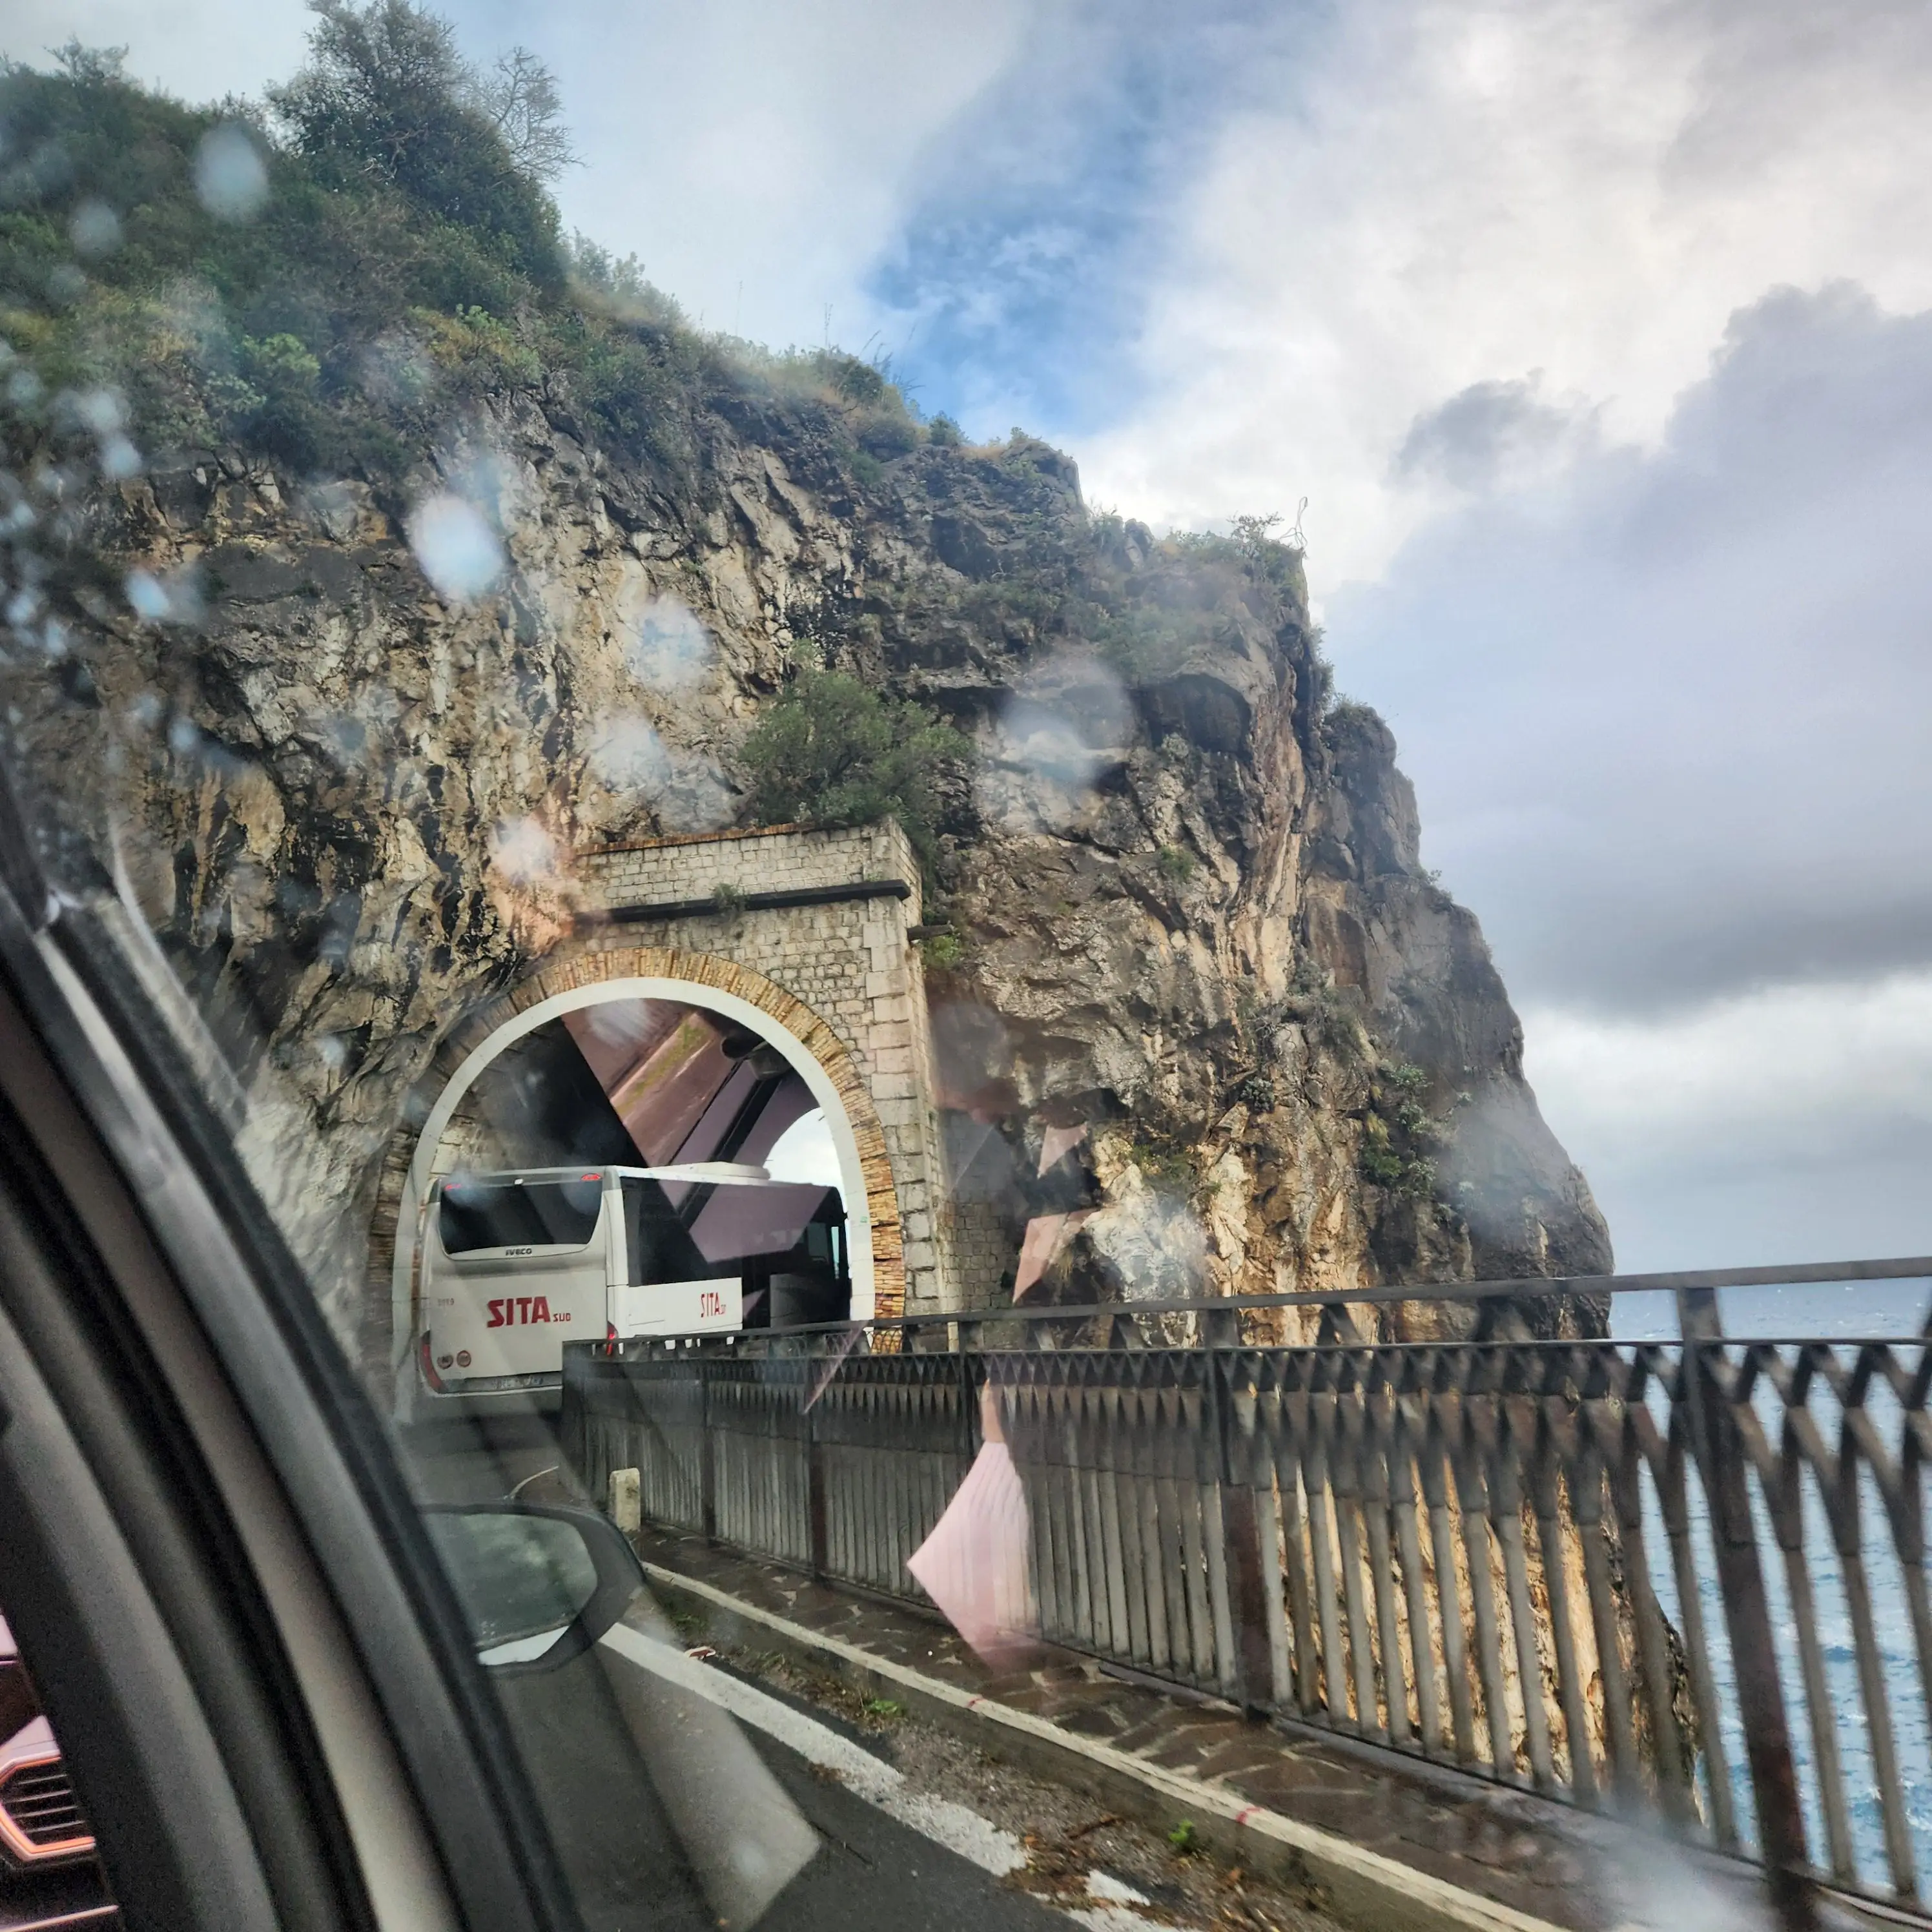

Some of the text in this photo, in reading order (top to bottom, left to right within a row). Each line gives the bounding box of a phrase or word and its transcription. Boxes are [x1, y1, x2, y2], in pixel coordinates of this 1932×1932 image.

[487, 1297, 571, 1328] SITA SUD
[701, 1292, 720, 1317] SITA
